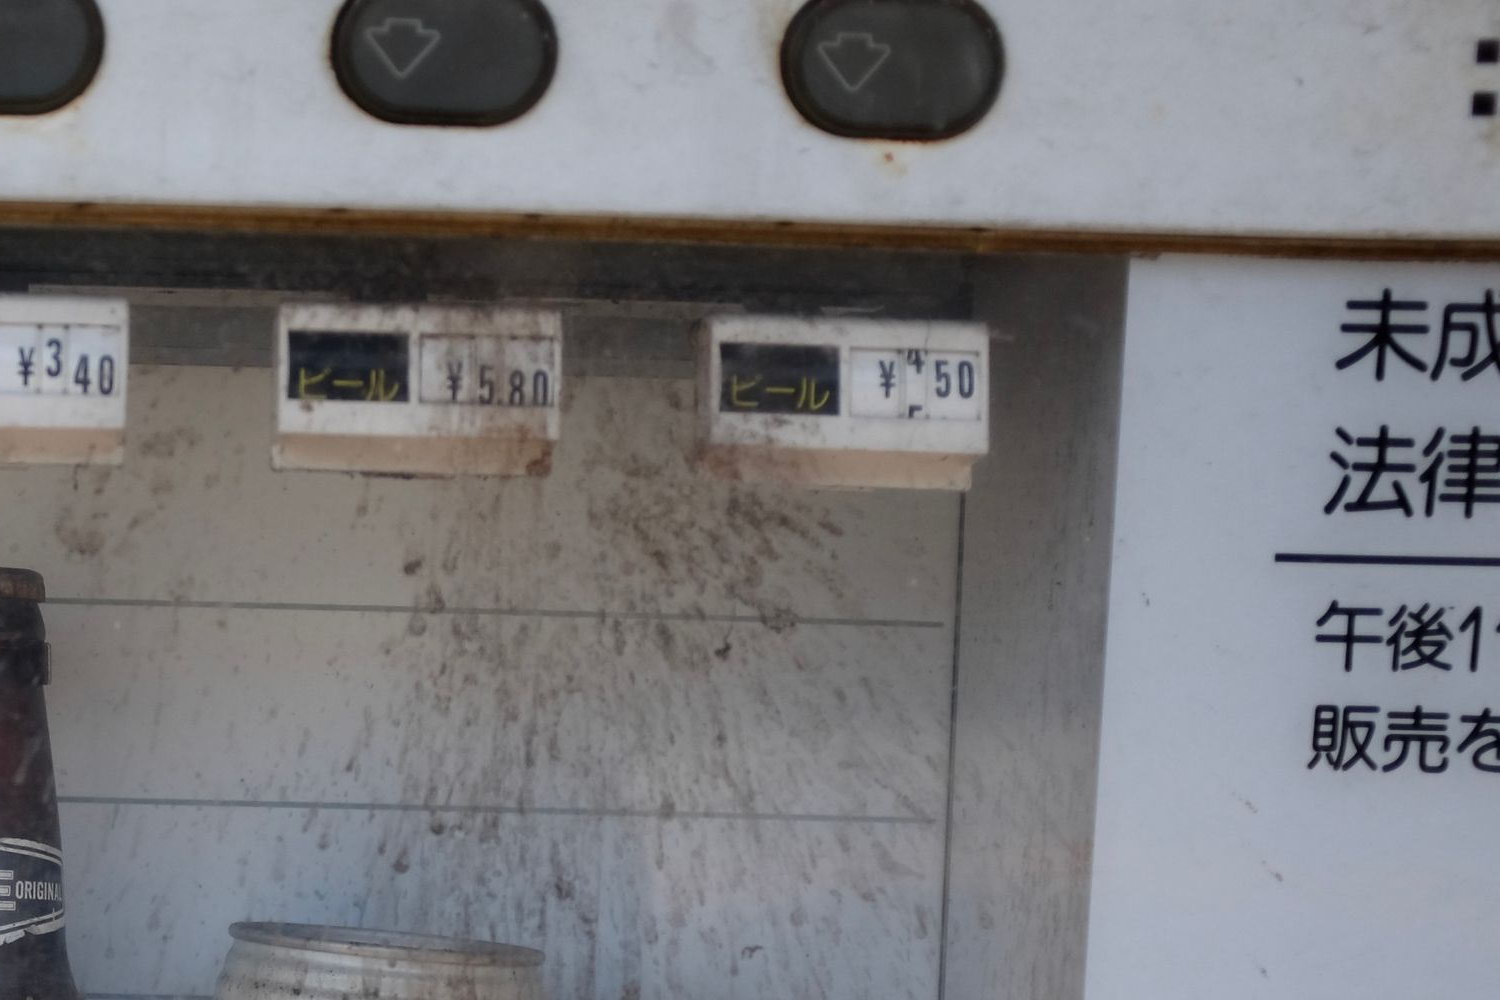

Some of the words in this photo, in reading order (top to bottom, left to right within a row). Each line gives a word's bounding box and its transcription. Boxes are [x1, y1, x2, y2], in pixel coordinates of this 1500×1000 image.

[1335, 287, 1500, 382] 未成
[18, 338, 114, 396] ¥340
[299, 367, 399, 401] ビール
[446, 361, 550, 406] ¥580
[731, 373, 831, 411] ビール
[1323, 424, 1500, 519] 法律
[1315, 600, 1500, 672] 午後1
[1307, 704, 1500, 774] 販売を
[15, 880, 63, 902] ORIGINAL
